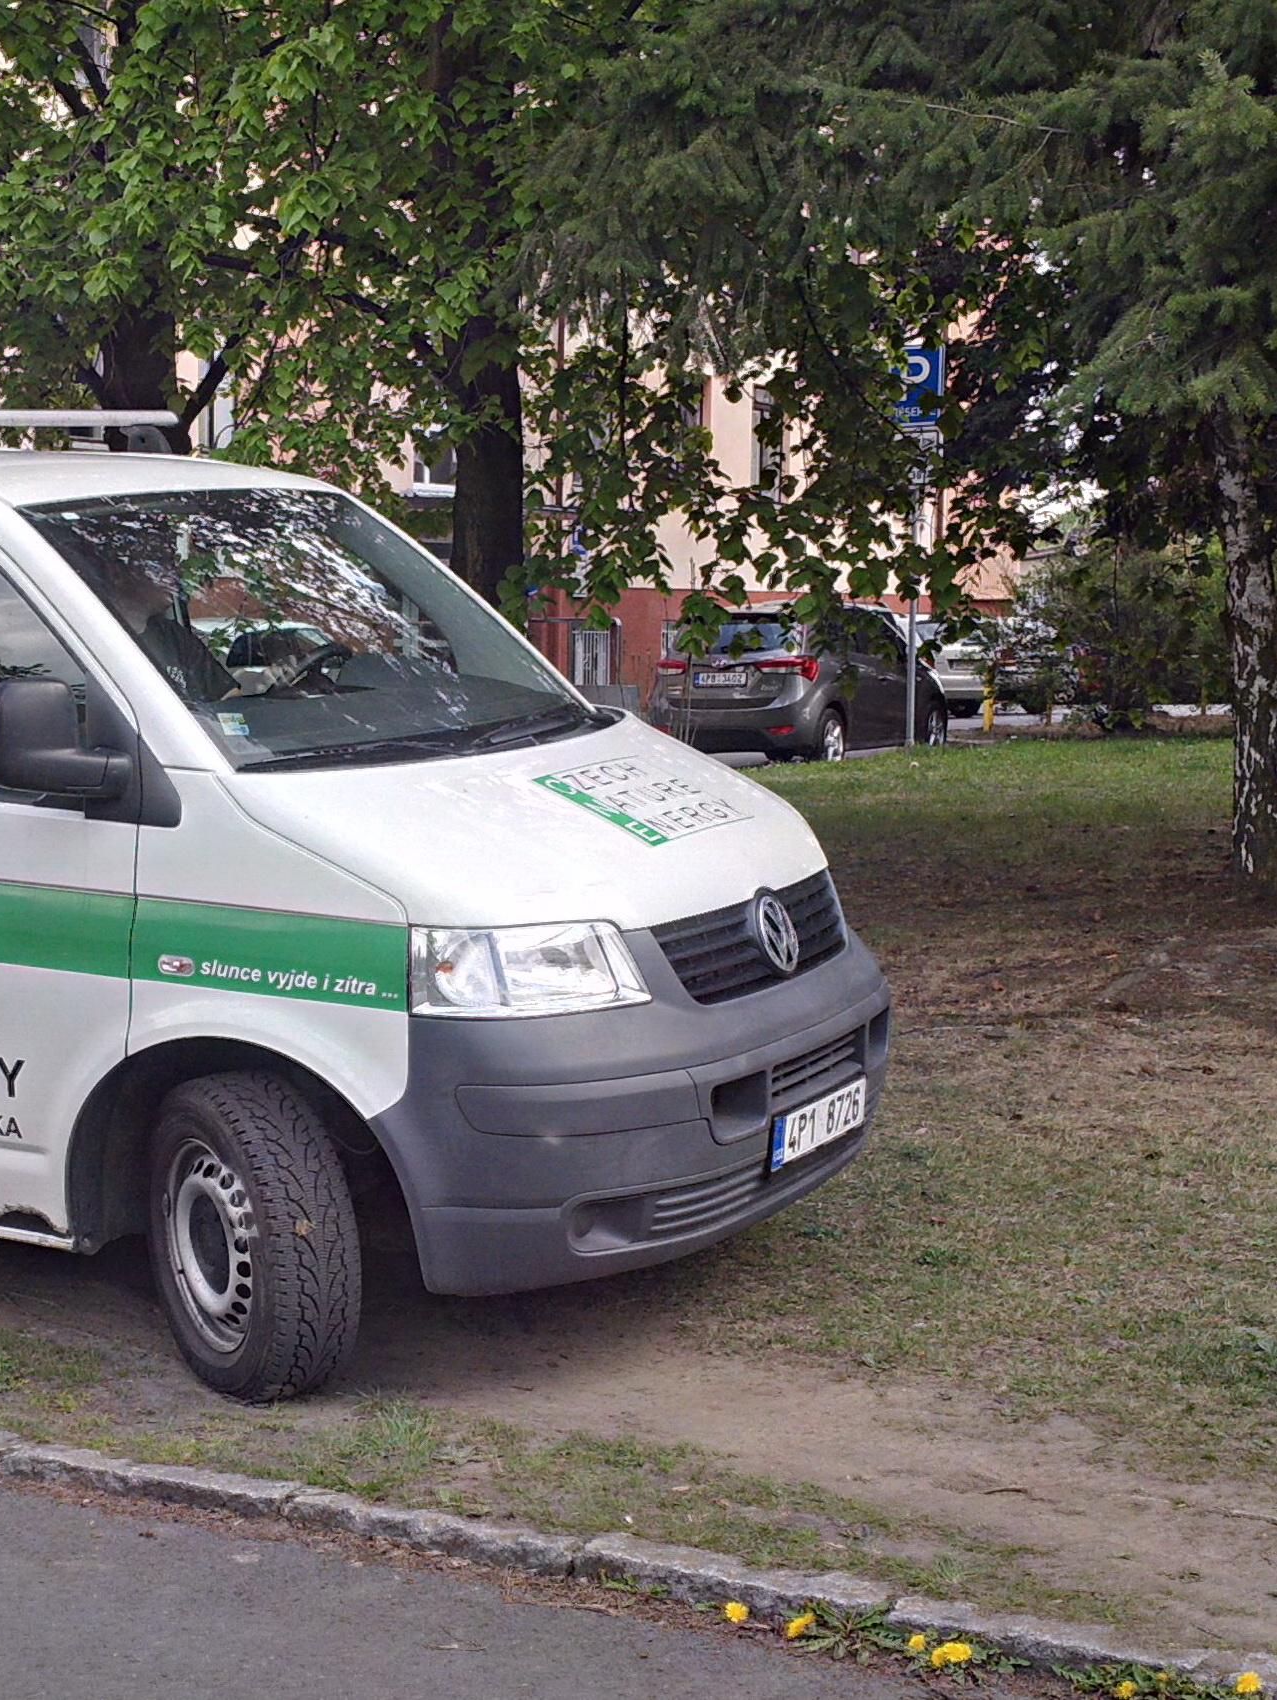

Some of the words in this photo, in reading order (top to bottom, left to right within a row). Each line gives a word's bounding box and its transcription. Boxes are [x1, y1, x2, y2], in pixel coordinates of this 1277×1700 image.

[544, 761, 648, 796] CZECH
[581, 777, 702, 819] NATURE
[624, 797, 742, 843] ENERGY
[200, 959, 261, 982] slunce
[267, 969, 318, 990] vyjde
[323, 973, 330, 992] i
[788, 1108, 817, 1153] 4P1
[826, 1086, 861, 1134] 8726
